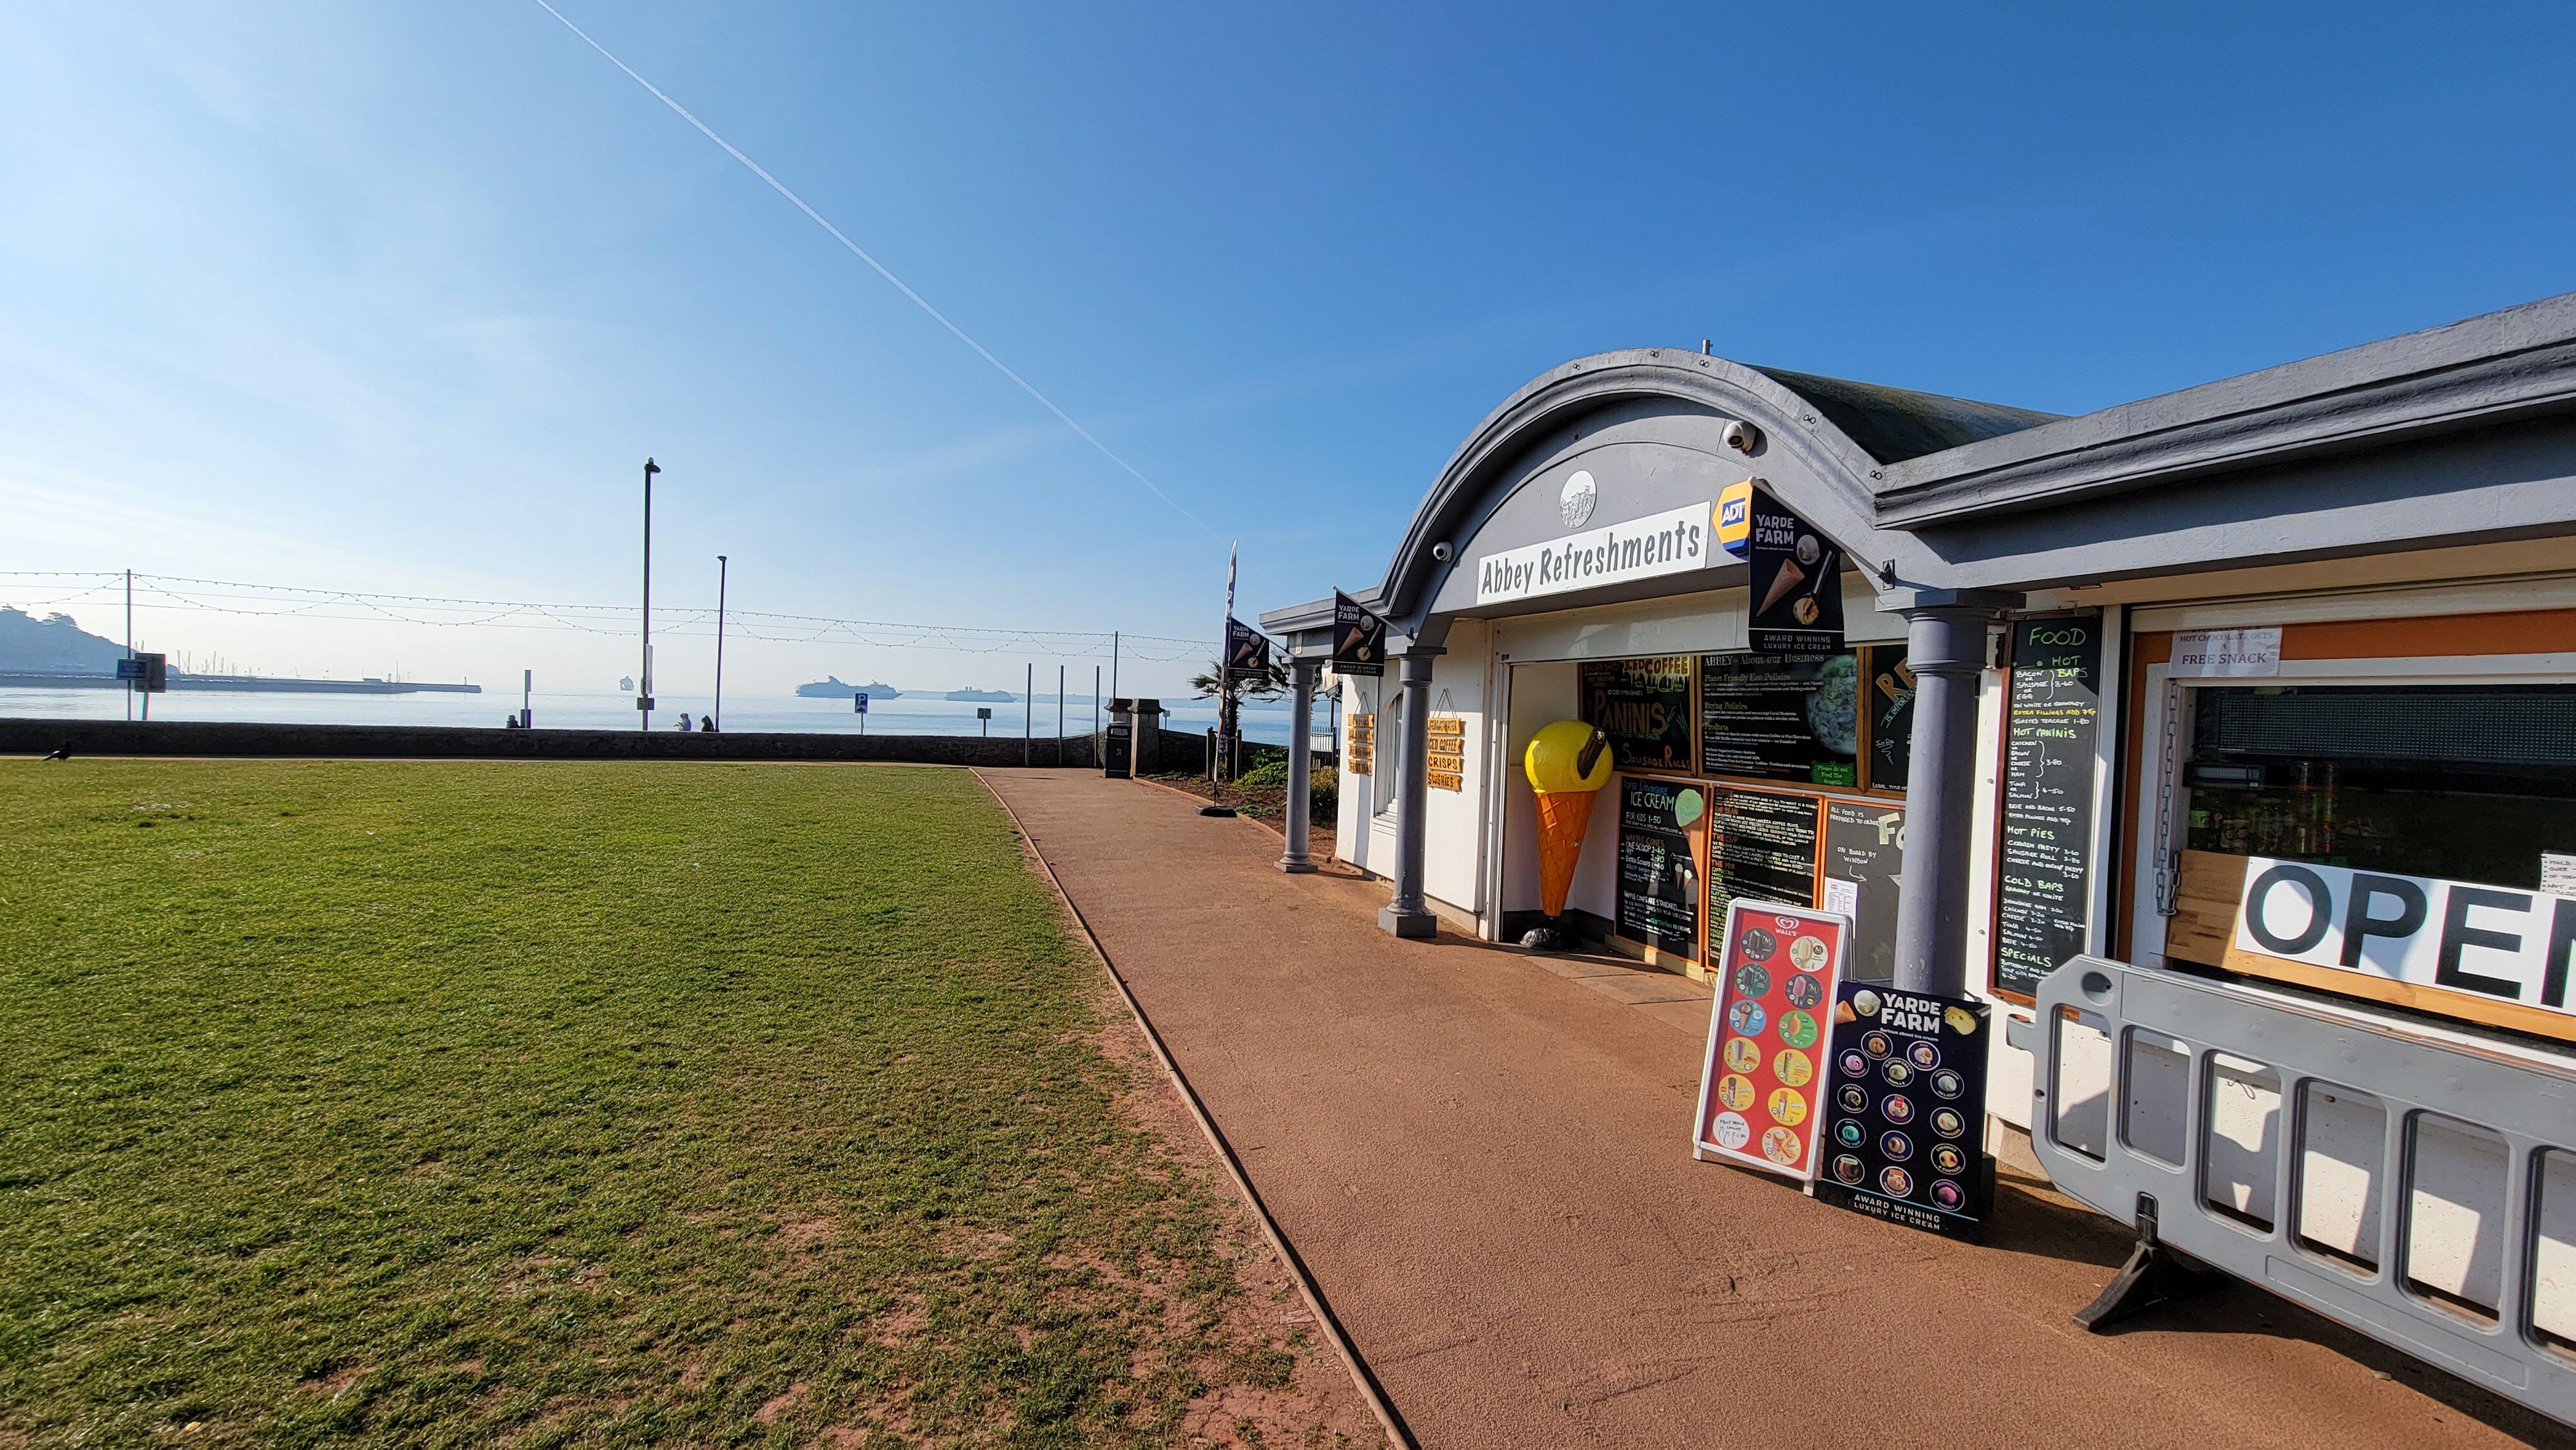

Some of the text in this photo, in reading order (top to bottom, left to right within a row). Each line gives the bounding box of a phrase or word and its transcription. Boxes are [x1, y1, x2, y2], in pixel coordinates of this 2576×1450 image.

[1722, 504, 1745, 524] ADT
[1756, 514, 1794, 529] YARDE
[1756, 529, 1794, 545] FARM
[1481, 521, 1700, 594] Abbey Refreshments
[1338, 612, 1359, 621] FARM
[2029, 626, 2087, 646] FOOD
[2198, 633, 2249, 641] CHOCOLATE
[1705, 656, 1732, 666] ABBEY
[1740, 655, 1763, 664] About
[1785, 654, 1824, 663] Business
[2052, 655, 2081, 667] HOT
[2183, 653, 2267, 664] FREE SNACK
[1645, 657, 1688, 674] COFFEE
[2057, 668, 2088, 678] BAPS
[858, 695, 866, 704] P
[1889, 686, 1917, 717] IMPORTAN
[2013, 728, 2035, 737] HOT
[1439, 739, 1456, 751] COFFEE
[1623, 743, 1690, 769] SAUSAGE ROLLS
[1428, 756, 1457, 770] CRISPS
[1631, 791, 1674, 812] ICE CREAM
[1626, 811, 1636, 820] FOR
[1636, 813, 1646, 822] KIDS
[1842, 809, 1855, 817] FOOD
[2007, 825, 2028, 835] HOT
[1712, 833, 1724, 842] THE
[1725, 835, 1739, 844] CUP
[1625, 841, 1636, 849] ONE
[1635, 842, 1651, 852] SCOOP
[2038, 843, 2060, 853] PASTY
[1711, 859, 1724, 868] THE
[1843, 856, 1868, 864] WINDOW
[2004, 875, 2064, 892] COLD BAPS
[1775, 928, 1797, 936] WALL'S
[2002, 937, 2017, 945] BRIE
[1882, 992, 1941, 1016] YARDE
[1881, 1008, 1940, 1034] FARM
[1854, 1194, 1940, 1223] AWARD WINNING
[1854, 1201, 1940, 1230] LUXURY ICE CREAM
